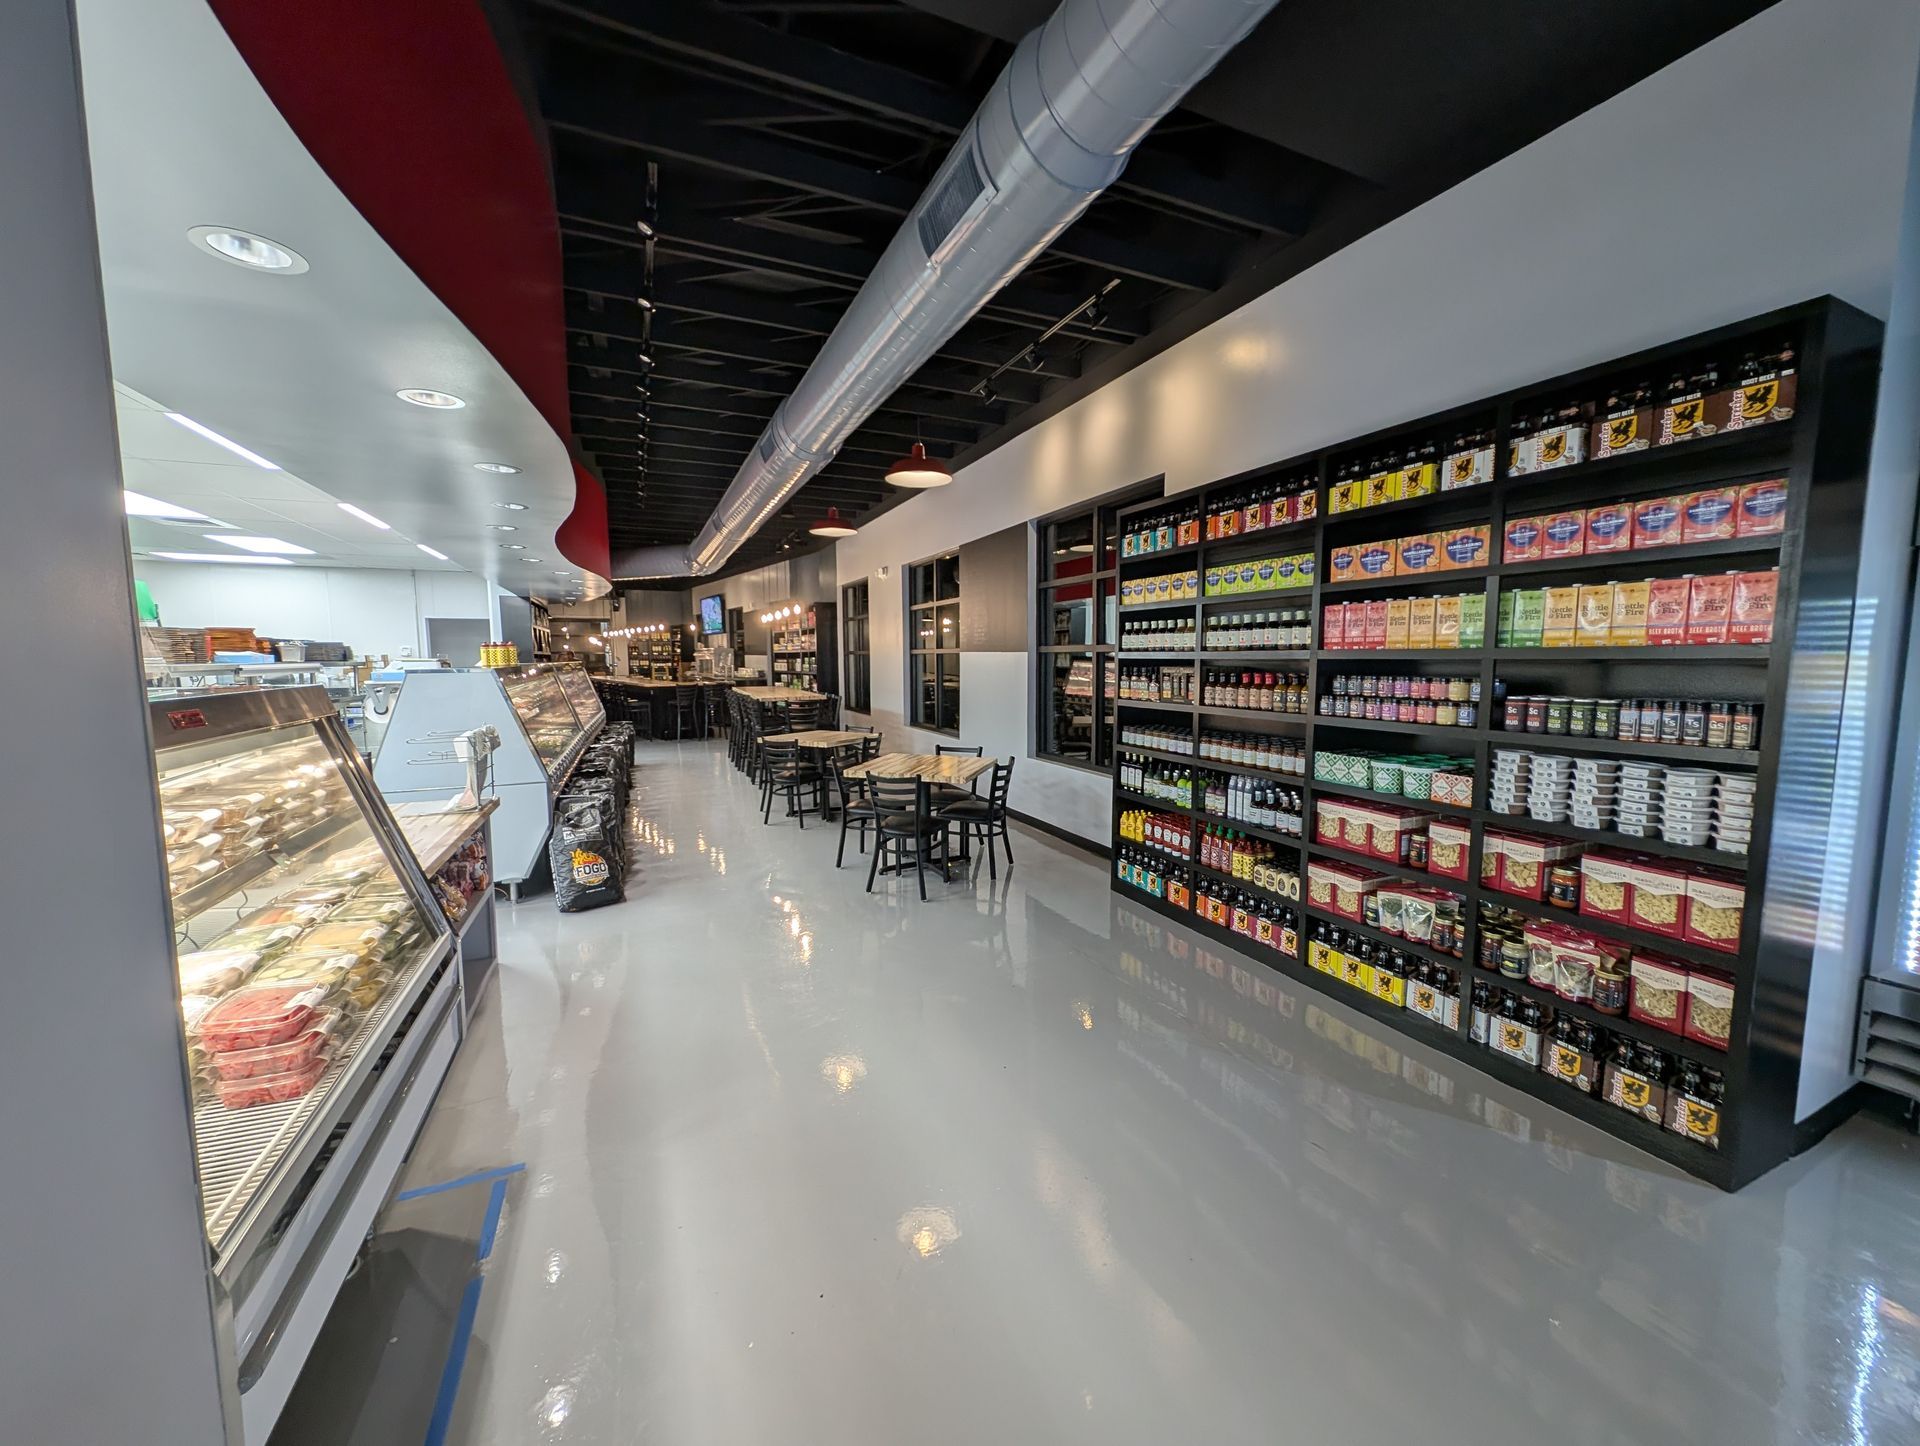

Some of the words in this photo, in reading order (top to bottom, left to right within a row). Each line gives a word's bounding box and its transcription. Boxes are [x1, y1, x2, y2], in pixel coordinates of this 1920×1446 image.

[1727, 388, 1745, 430] Sprecher
[1659, 408, 1675, 446] Sprecher
[1598, 422, 1612, 458] Sprecher
[1549, 606, 1573, 614] Kettle
[1507, 706, 1517, 714] Sc
[1529, 707, 1538, 715] Sc
[1550, 708, 1560, 717] Sg
[1572, 709, 1583, 718] Sg
[1597, 711, 1608, 720] Sg
[1664, 717, 1677, 727] Ts
[1686, 718, 1700, 728] Ts
[1709, 720, 1725, 730] Gs
[1734, 721, 1748, 731] Gs
[576, 862, 607, 877] FOGO
